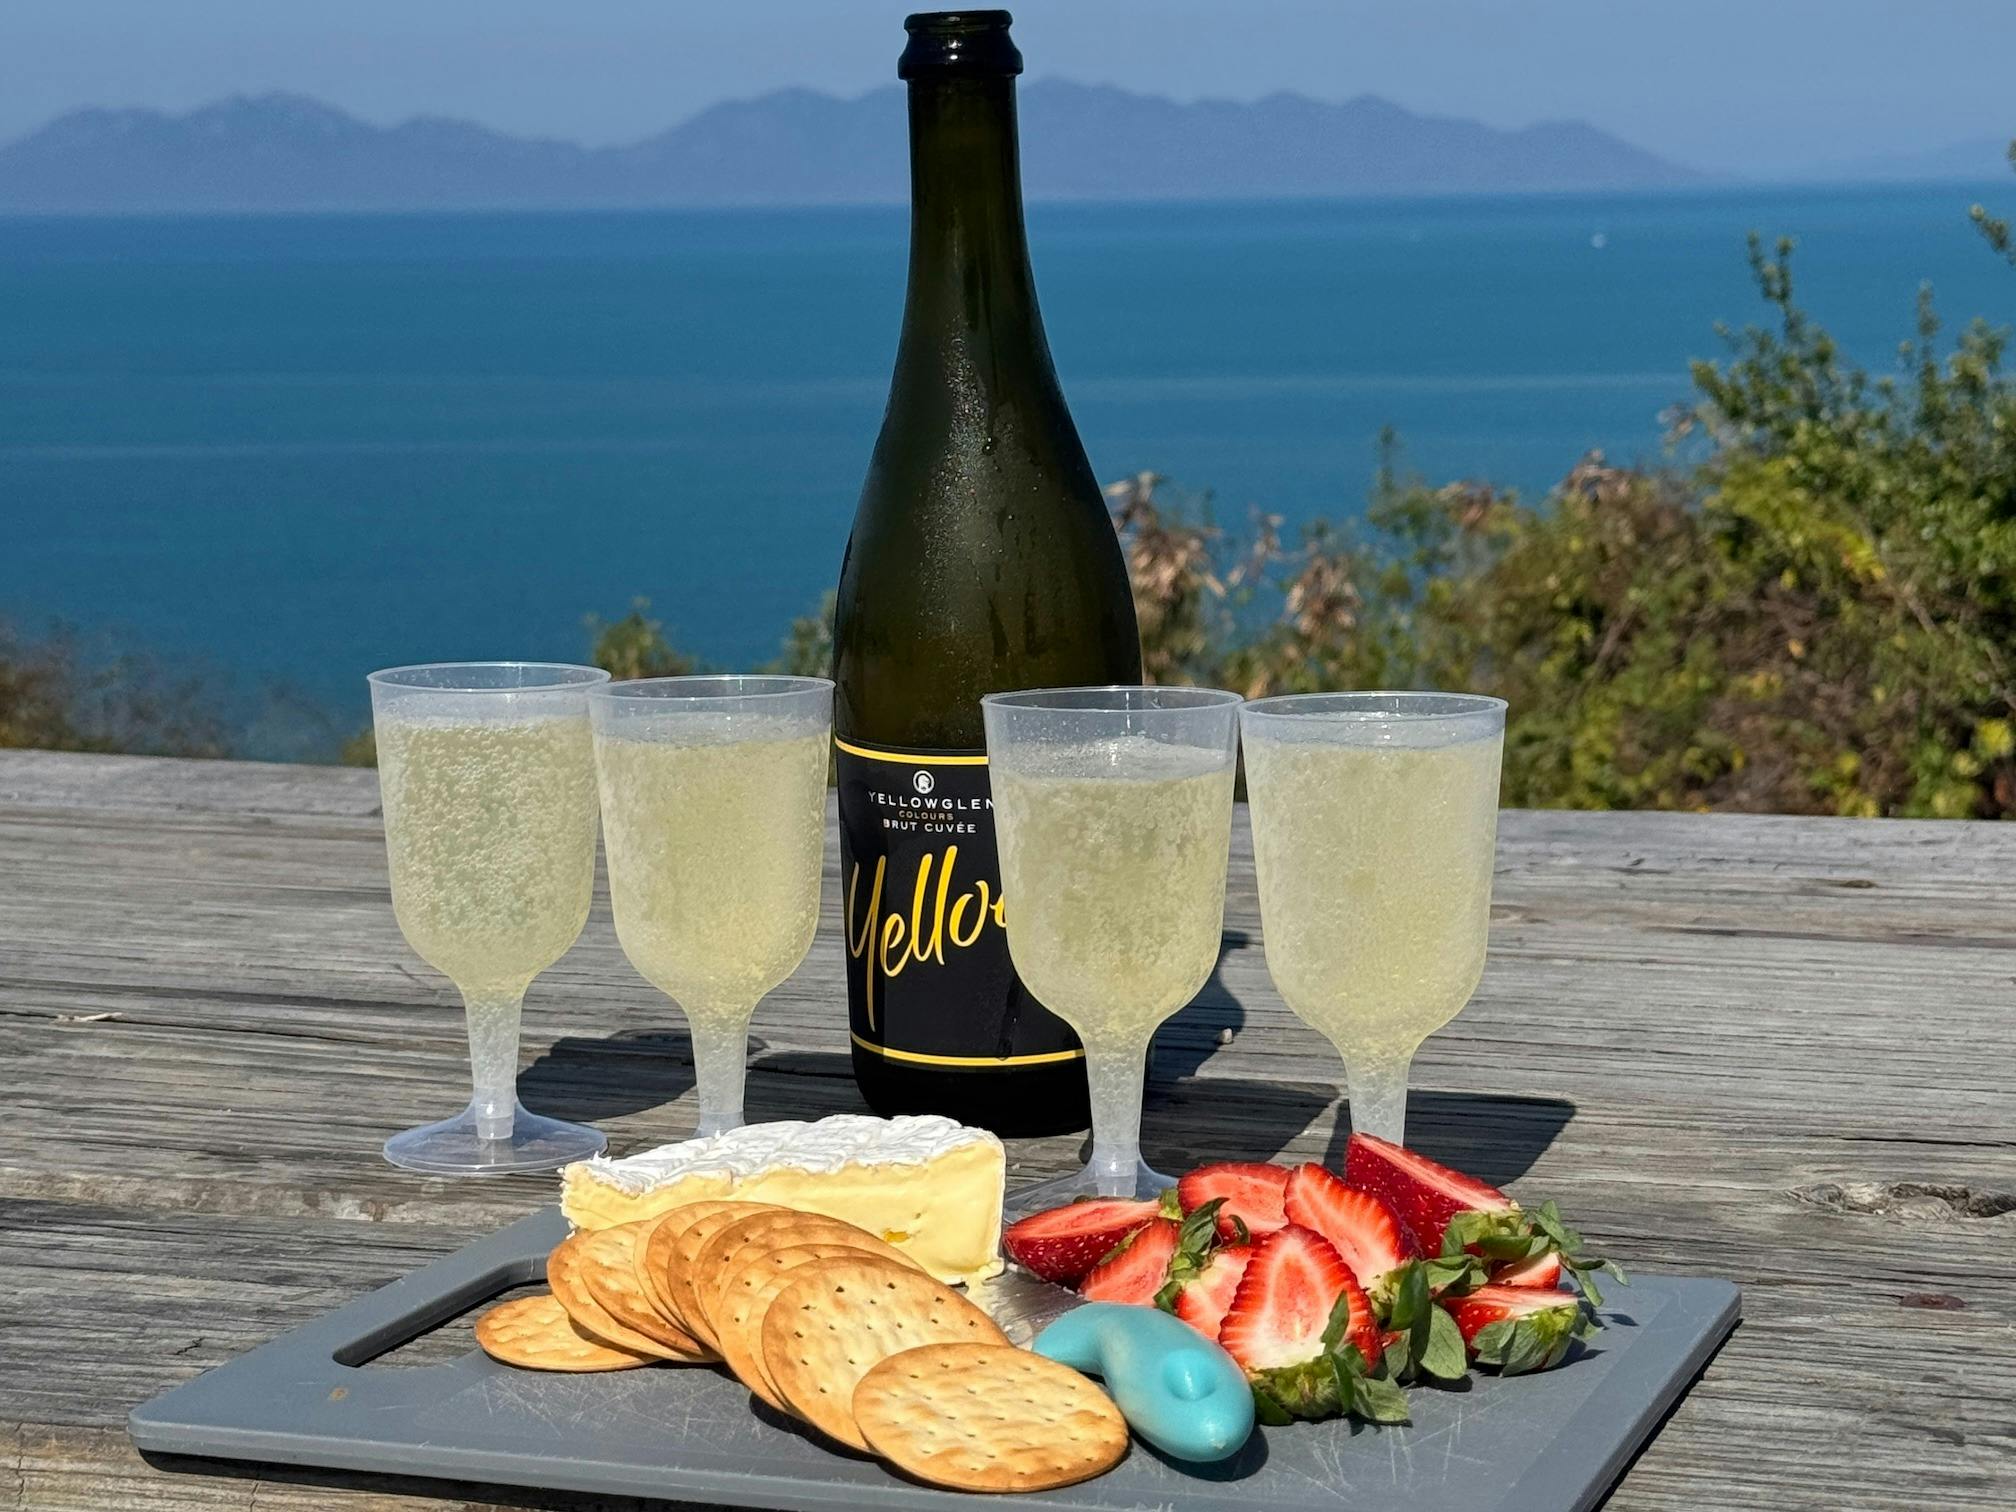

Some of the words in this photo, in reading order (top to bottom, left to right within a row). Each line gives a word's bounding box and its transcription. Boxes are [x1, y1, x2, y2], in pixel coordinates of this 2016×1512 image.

[898, 810, 954, 820] COLOURS
[883, 818, 918, 831] BRUT
[924, 821, 976, 833] CUVÉE
